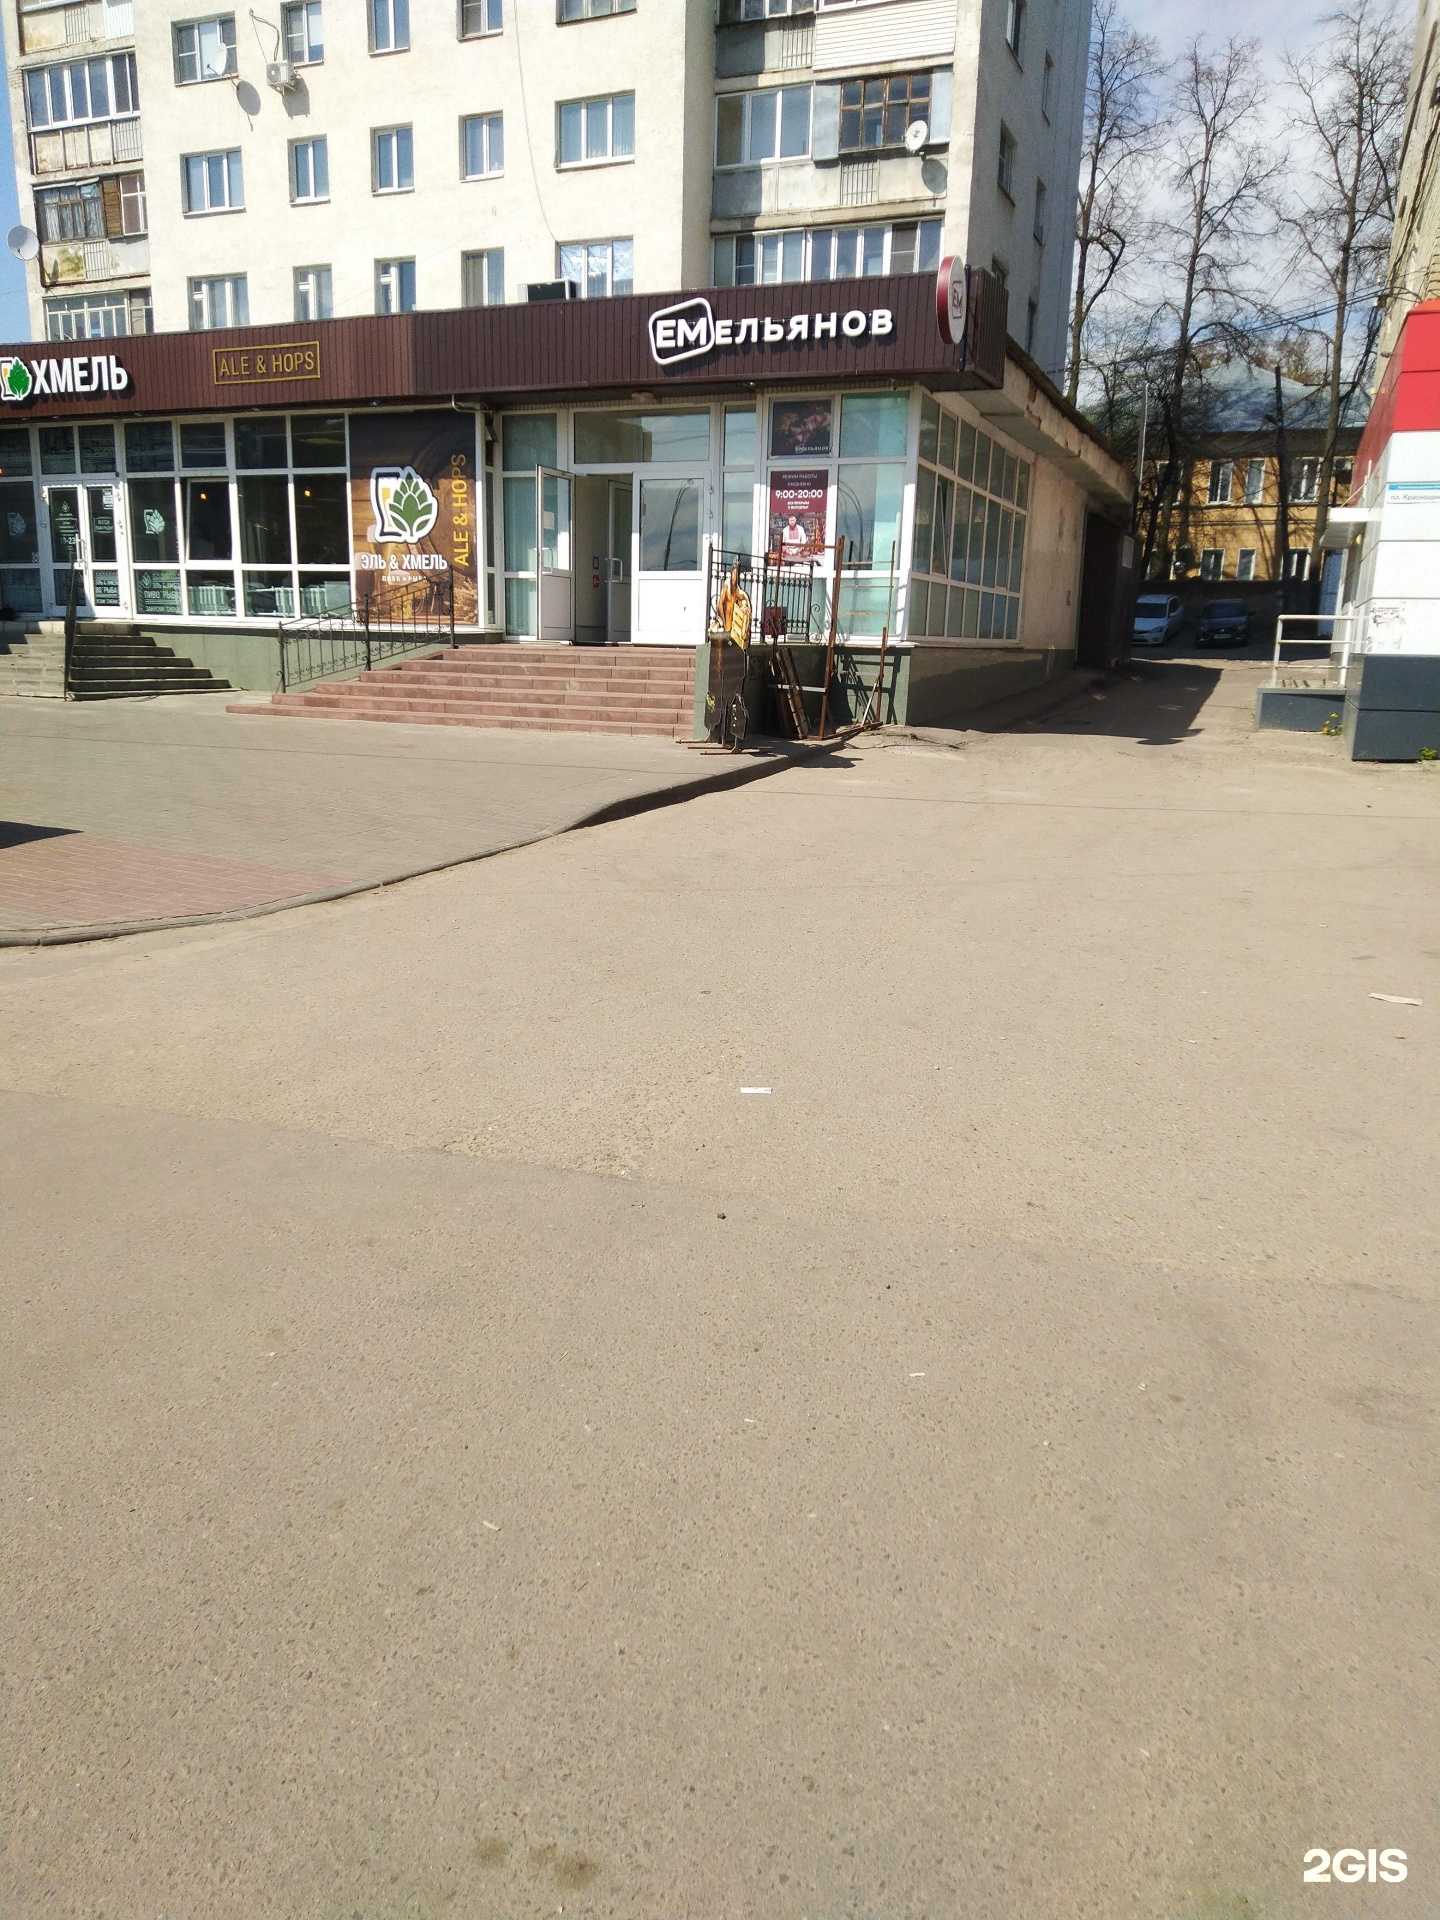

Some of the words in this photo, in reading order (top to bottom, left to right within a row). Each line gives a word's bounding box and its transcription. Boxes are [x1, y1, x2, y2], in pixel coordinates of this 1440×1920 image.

[31, 355, 129, 395] ХМЕЛЬ
[219, 356, 250, 376] ALE
[256, 355, 266, 374] &
[272, 351, 315, 373] HOPS
[451, 454, 467, 508] HOPS
[775, 489, 823, 498] 9:00-20:00
[453, 513, 468, 526] &
[453, 530, 469, 566] ALE
[361, 554, 386, 569] ЭЛЬ
[389, 555, 399, 569] &
[402, 554, 448, 569] ХМЕЛЬ
